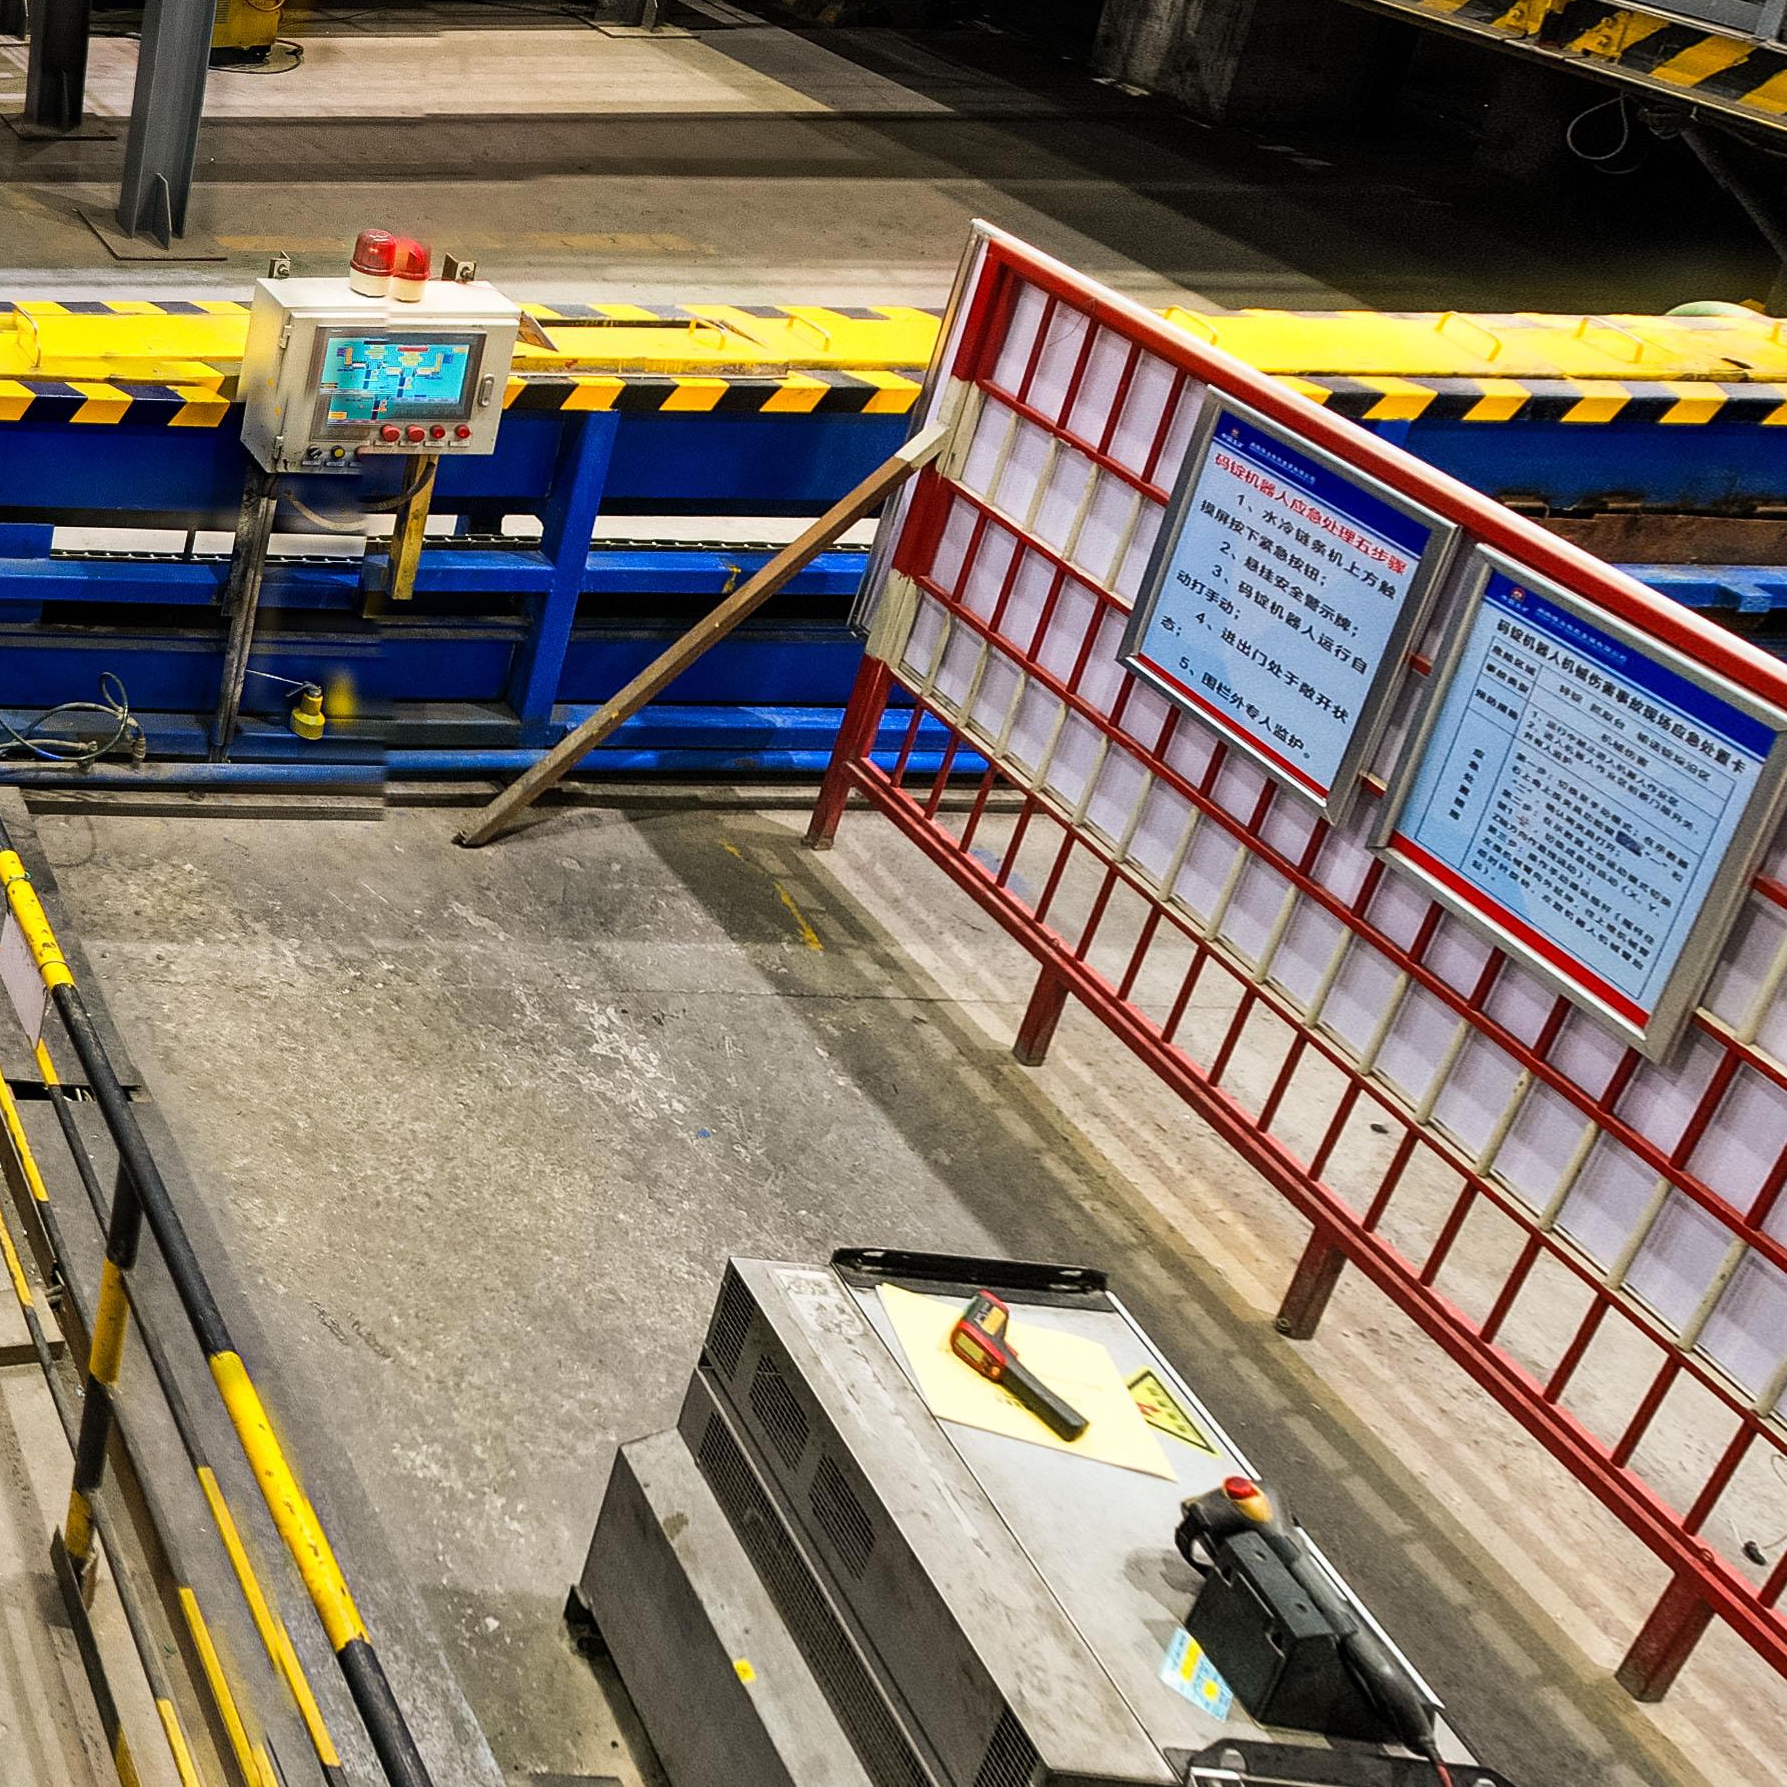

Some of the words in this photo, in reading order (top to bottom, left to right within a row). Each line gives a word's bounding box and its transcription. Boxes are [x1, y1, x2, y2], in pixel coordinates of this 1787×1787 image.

[1212, 450, 1408, 578] 码锭机器人应急处理五步骤
[1233, 490, 1398, 602] 1、水冷链条机上方触
[1159, 612, 1183, 639] 态；
[1174, 566, 1242, 622] 动打手动；
[1209, 561, 1369, 676] 3、码锭机器人运行自
[1218, 537, 1360, 640] 2、悬挂安全警示牌；
[1177, 653, 1314, 762] 5、围栏外专人监护。
[1193, 607, 1350, 727] 4、进出门处于敞开状
[1494, 616, 1750, 777] 码锭机器人机械伤害事故现场应急处置卡
[1599, 731, 1649, 769] 机械伤害
